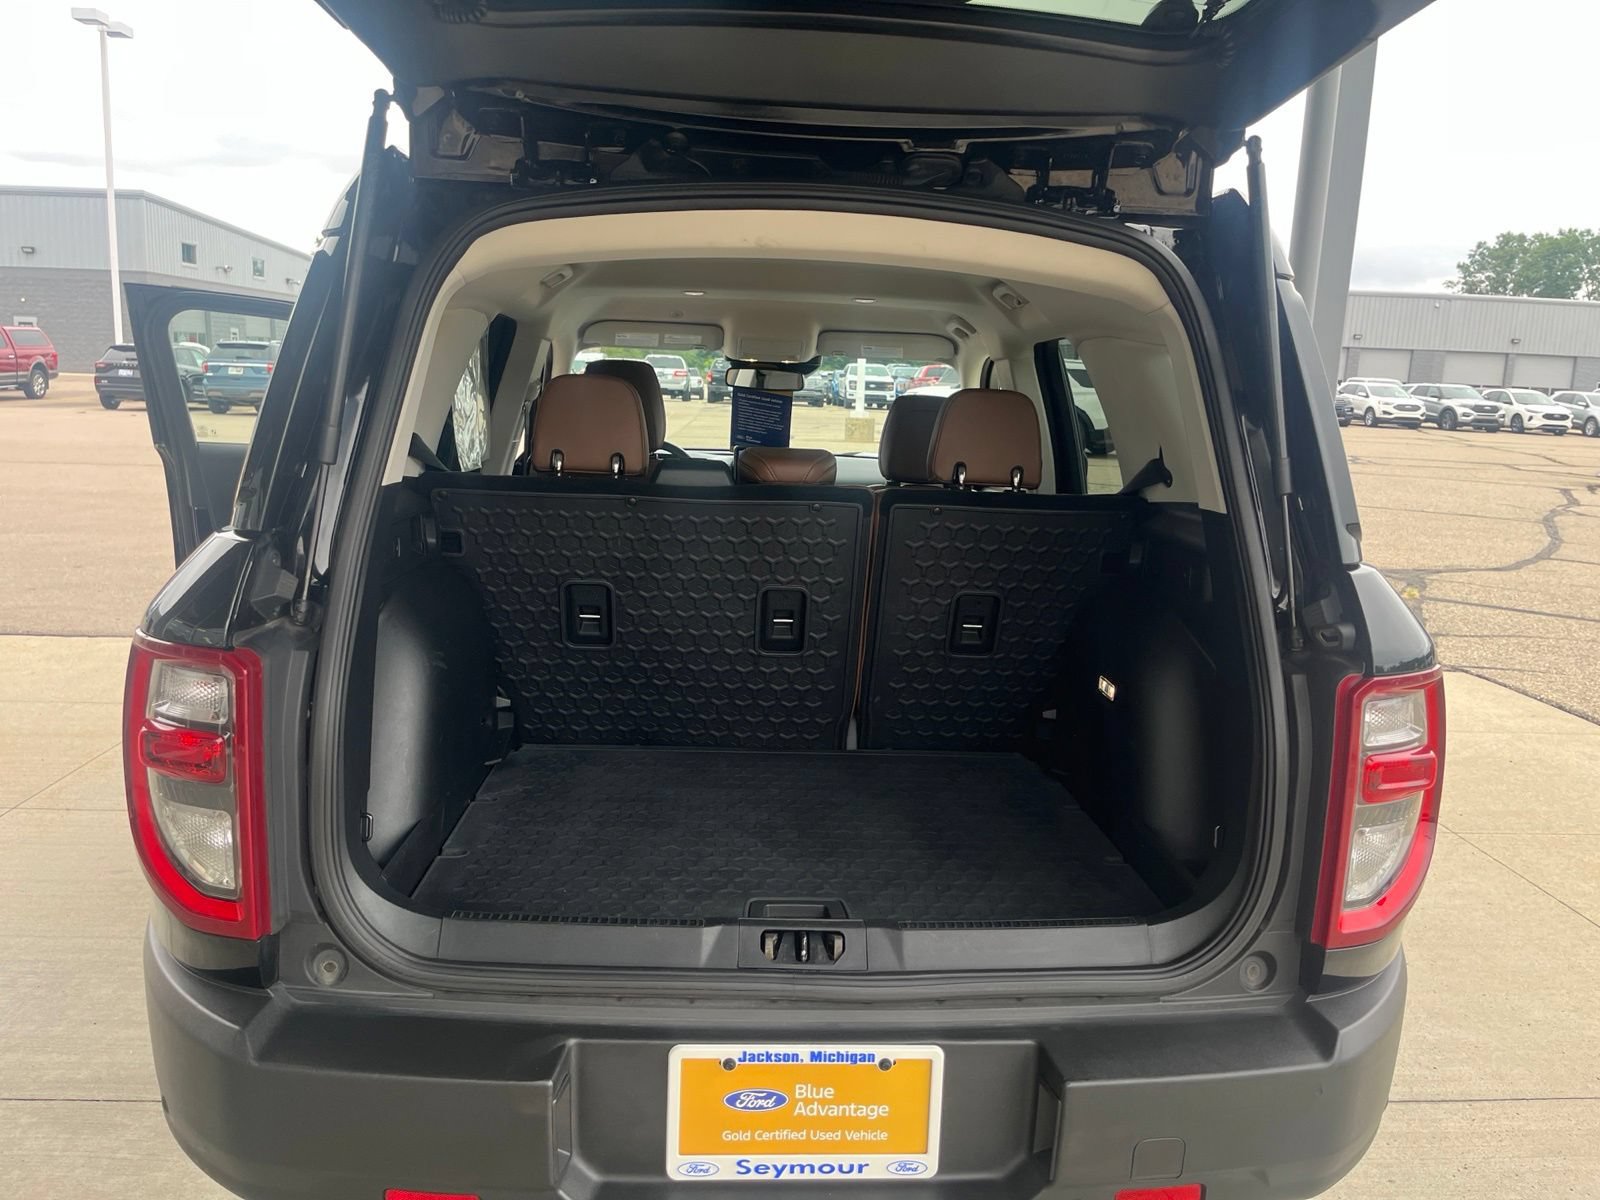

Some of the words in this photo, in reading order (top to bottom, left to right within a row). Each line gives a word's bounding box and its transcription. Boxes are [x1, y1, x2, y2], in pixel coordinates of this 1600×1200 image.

[737, 1050, 804, 1063] Jackson,
[810, 1050, 876, 1065] Michigan
[794, 1084, 835, 1099] Blue
[735, 1092, 777, 1109] Ford
[793, 1102, 890, 1120] Advantage
[722, 1130, 751, 1142] Gold
[754, 1129, 807, 1141] Certified
[810, 1129, 842, 1141] Used
[845, 1129, 888, 1141] Vehicle
[686, 1163, 711, 1175] Ford
[736, 1159, 870, 1179] Seymour
[894, 1162, 920, 1174] Ford
